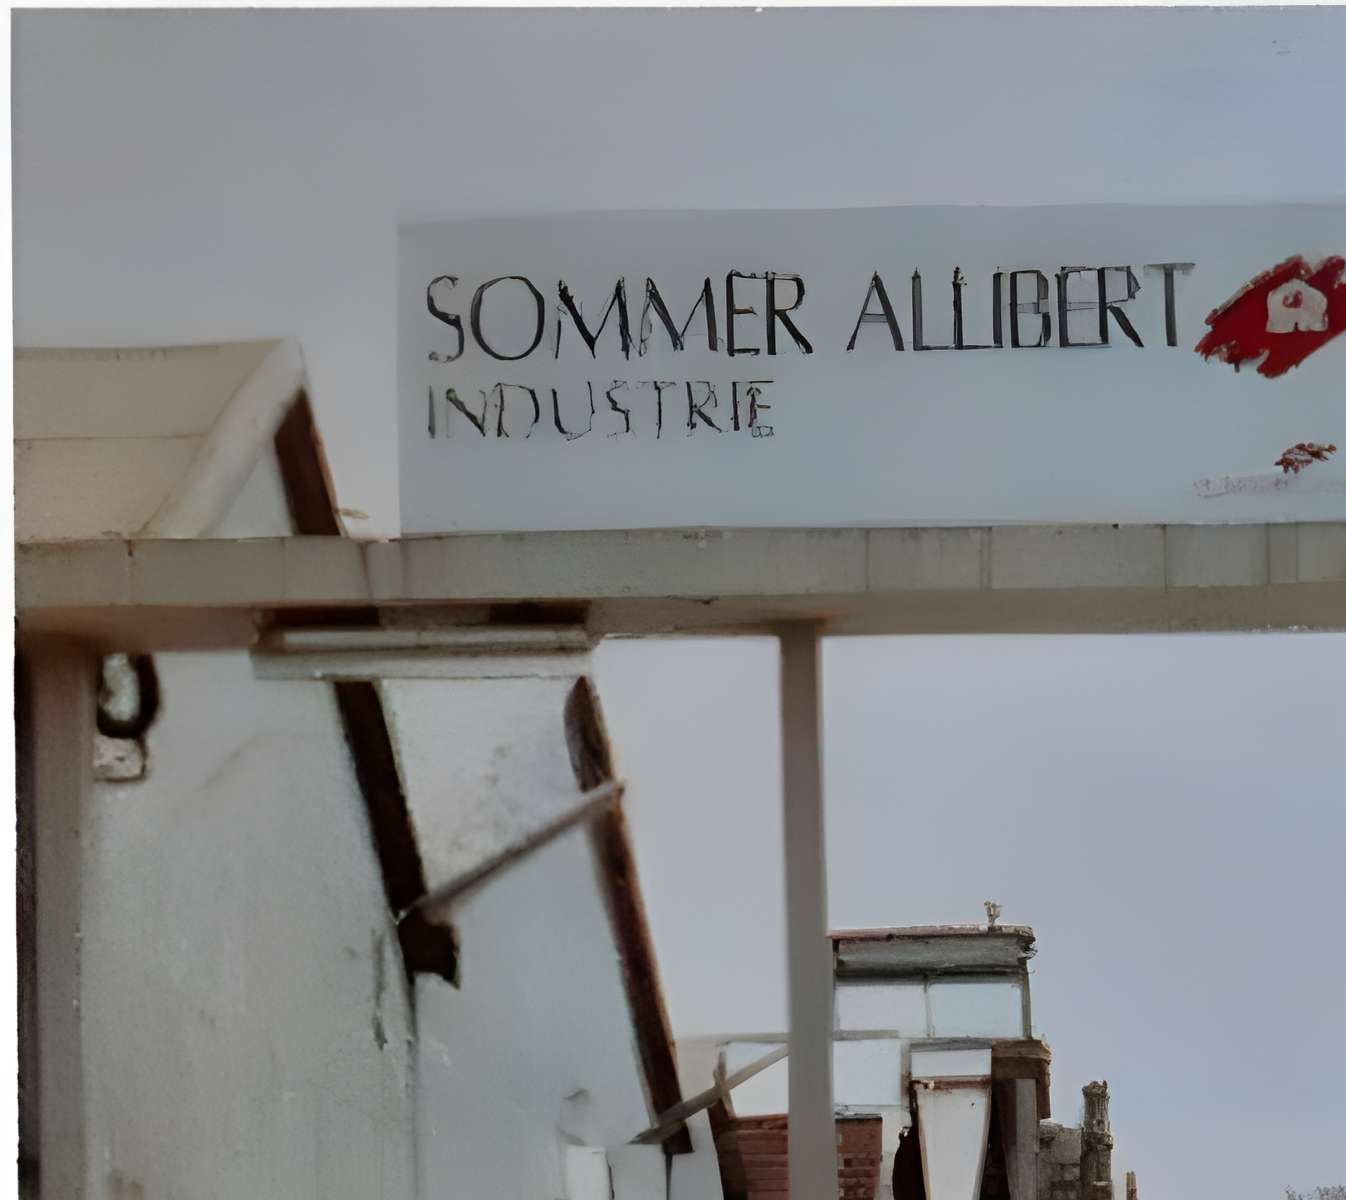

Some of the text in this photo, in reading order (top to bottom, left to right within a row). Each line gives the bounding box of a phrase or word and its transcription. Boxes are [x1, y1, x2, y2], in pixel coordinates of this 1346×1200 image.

[425, 262, 1196, 363] SOMMER ALLIBERT
[427, 380, 776, 441] INDUSTRIE
